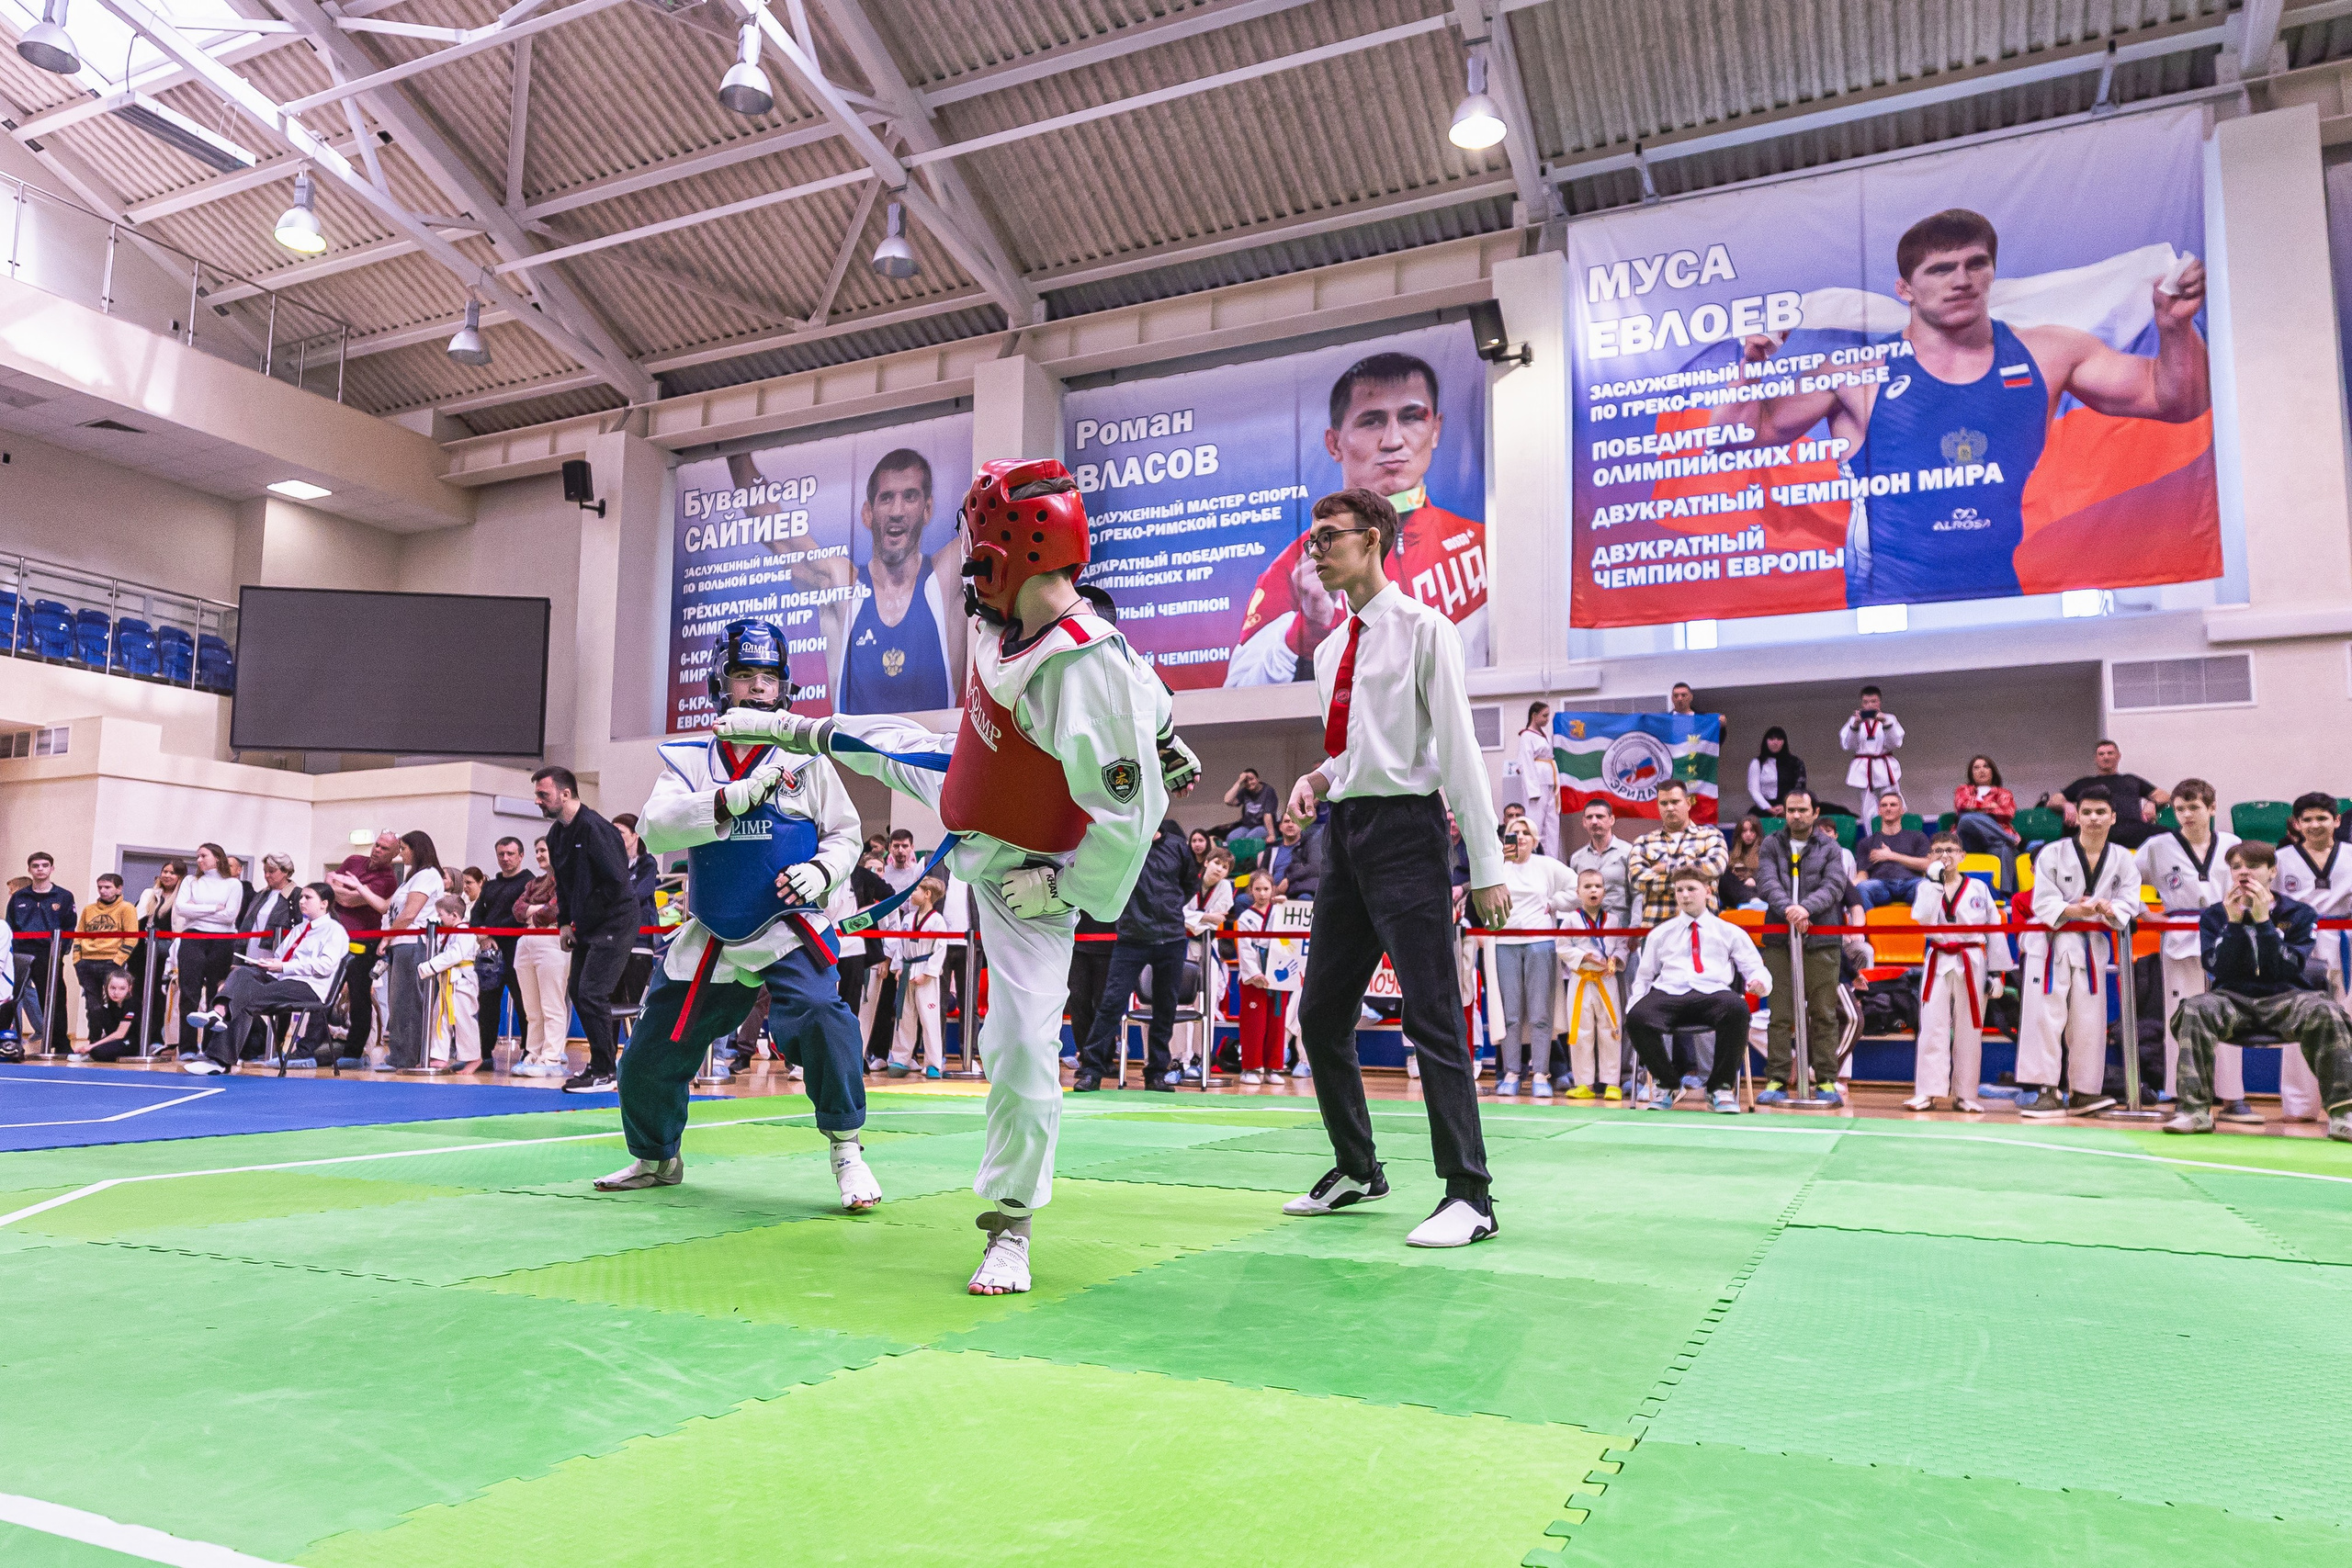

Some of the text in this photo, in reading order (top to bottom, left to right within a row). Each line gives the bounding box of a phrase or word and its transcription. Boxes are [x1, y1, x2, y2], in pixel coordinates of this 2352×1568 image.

[1588, 243, 1738, 304] МУСА
[1587, 289, 1805, 361] ЕВЛОЕВ
[1589, 340, 1916, 400] ЗАСЛУЖЕННЫЙ МАСТЕР СПОРТА
[1589, 366, 1890, 423] ПО ГРЕКО-РИМСКОЙ БОРЬБЕ
[1075, 407, 1194, 450] Роман
[1592, 423, 1757, 461] ПОБЕДИТЕЛЬ
[1076, 444, 1220, 494] ВЛАСОВ
[1592, 437, 1851, 488] ОЛИМПИЙСКИХ ИГР
[684, 474, 818, 521] Бувайсар
[1088, 485, 1309, 528] АСЛУЖЕННЫЙ МАСТЕР СПОРТА
[1590, 461, 2005, 530] ДВУКРАТНЫЙ ЧЕМПИОН МИРА
[684, 509, 810, 554] САЙТИЕВ
[1100, 514, 1217, 543] ГРЕКО-РИМСКОЙ
[1220, 506, 1283, 528] БОРЬБЕ
[684, 545, 849, 579] ЗАСЛУЖЕННЫЙ МАСТЕР СПОРТА
[1079, 542, 1265, 579] ДВУКРАТНЫЙ ПОБЕДИТЕЛЬ
[1590, 525, 1766, 570] ДВУКРАТНЫЙ
[683, 569, 792, 594] ПО ВОЛЬНОЙ БОРЬБЕ
[1186, 567, 1214, 582] ИГР
[1593, 546, 1845, 590] ЧЕМПИОН ЕВРОПЫ
[682, 584, 873, 621] ТРЁХКРАТНЫЙ ПОБЕДИТЕЛЬ
[787, 609, 813, 626] ИГР
[1158, 596, 1229, 616] ЧЕМПИОН
[788, 636, 827, 654] ПИОН
[1158, 647, 1229, 666] ЧЕМПИОН
[680, 668, 707, 683] МИР
[677, 713, 718, 729] ЕВРОП
[1610, 780, 1657, 801] ЭРИДА
[1046, 874, 1058, 899] KHAN
